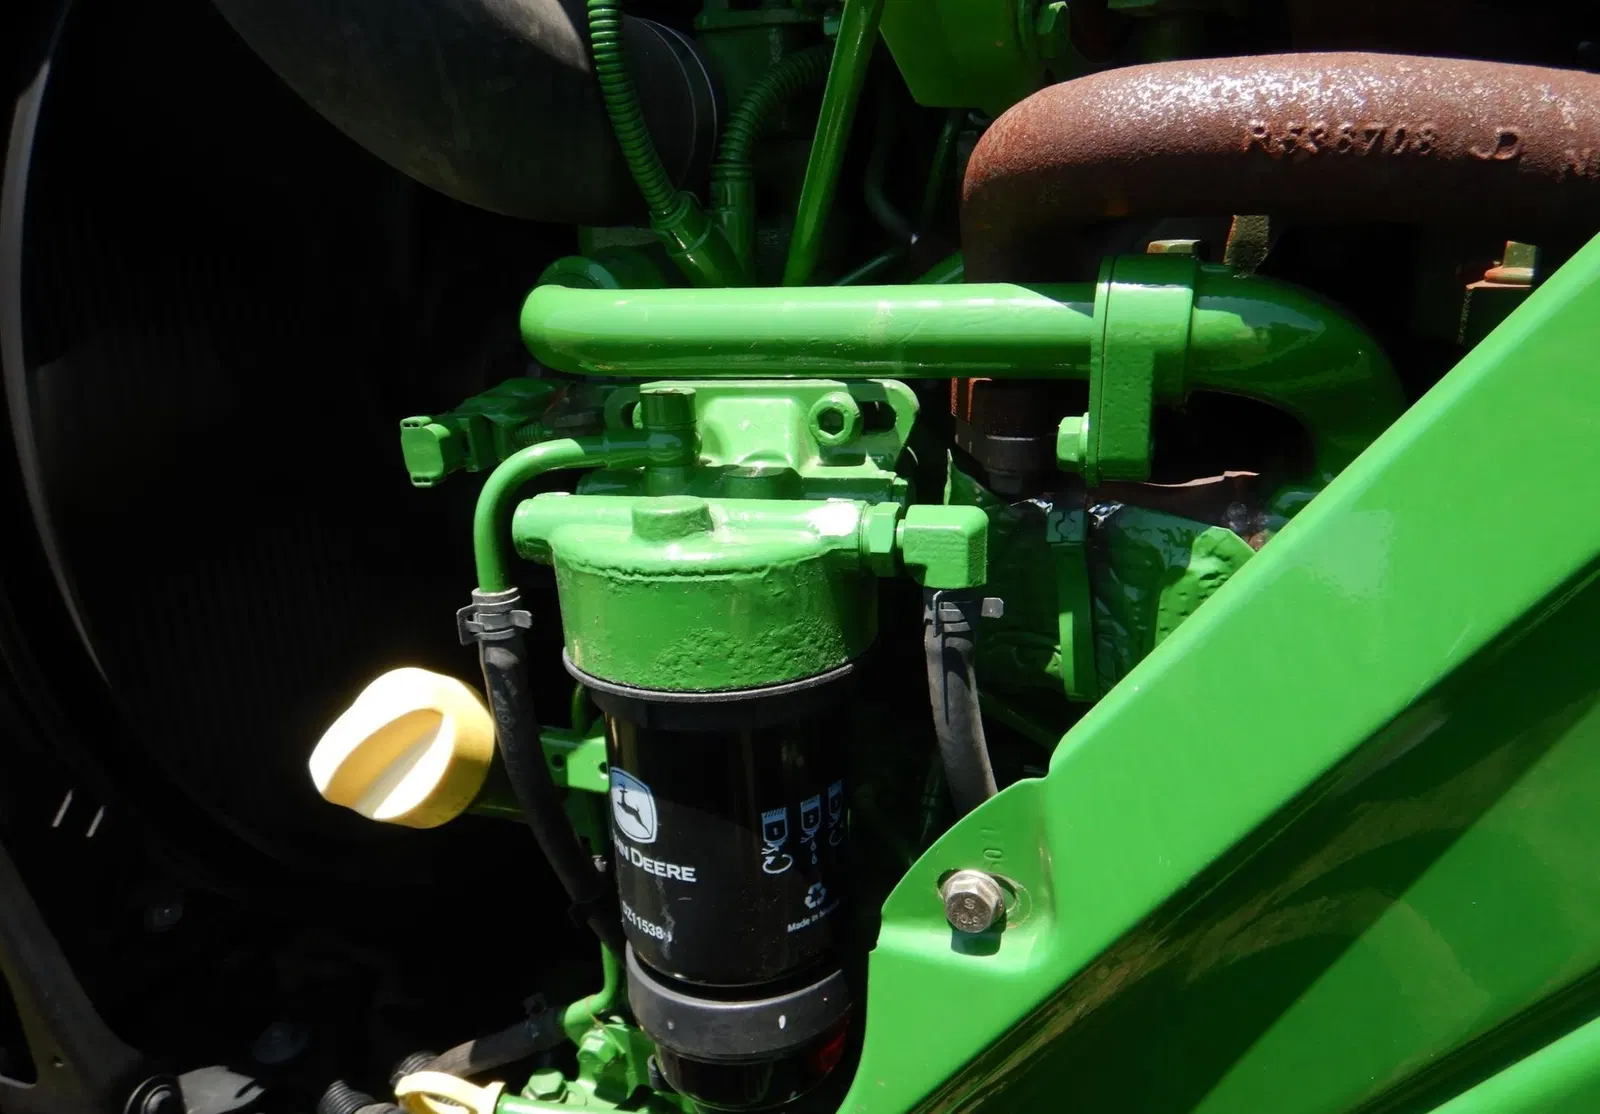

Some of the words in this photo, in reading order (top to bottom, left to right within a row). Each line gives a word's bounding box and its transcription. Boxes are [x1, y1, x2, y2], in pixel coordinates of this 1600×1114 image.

[612, 829, 630, 861] HN
[630, 846, 697, 883] DEERE
[787, 917, 811, 933] Made
